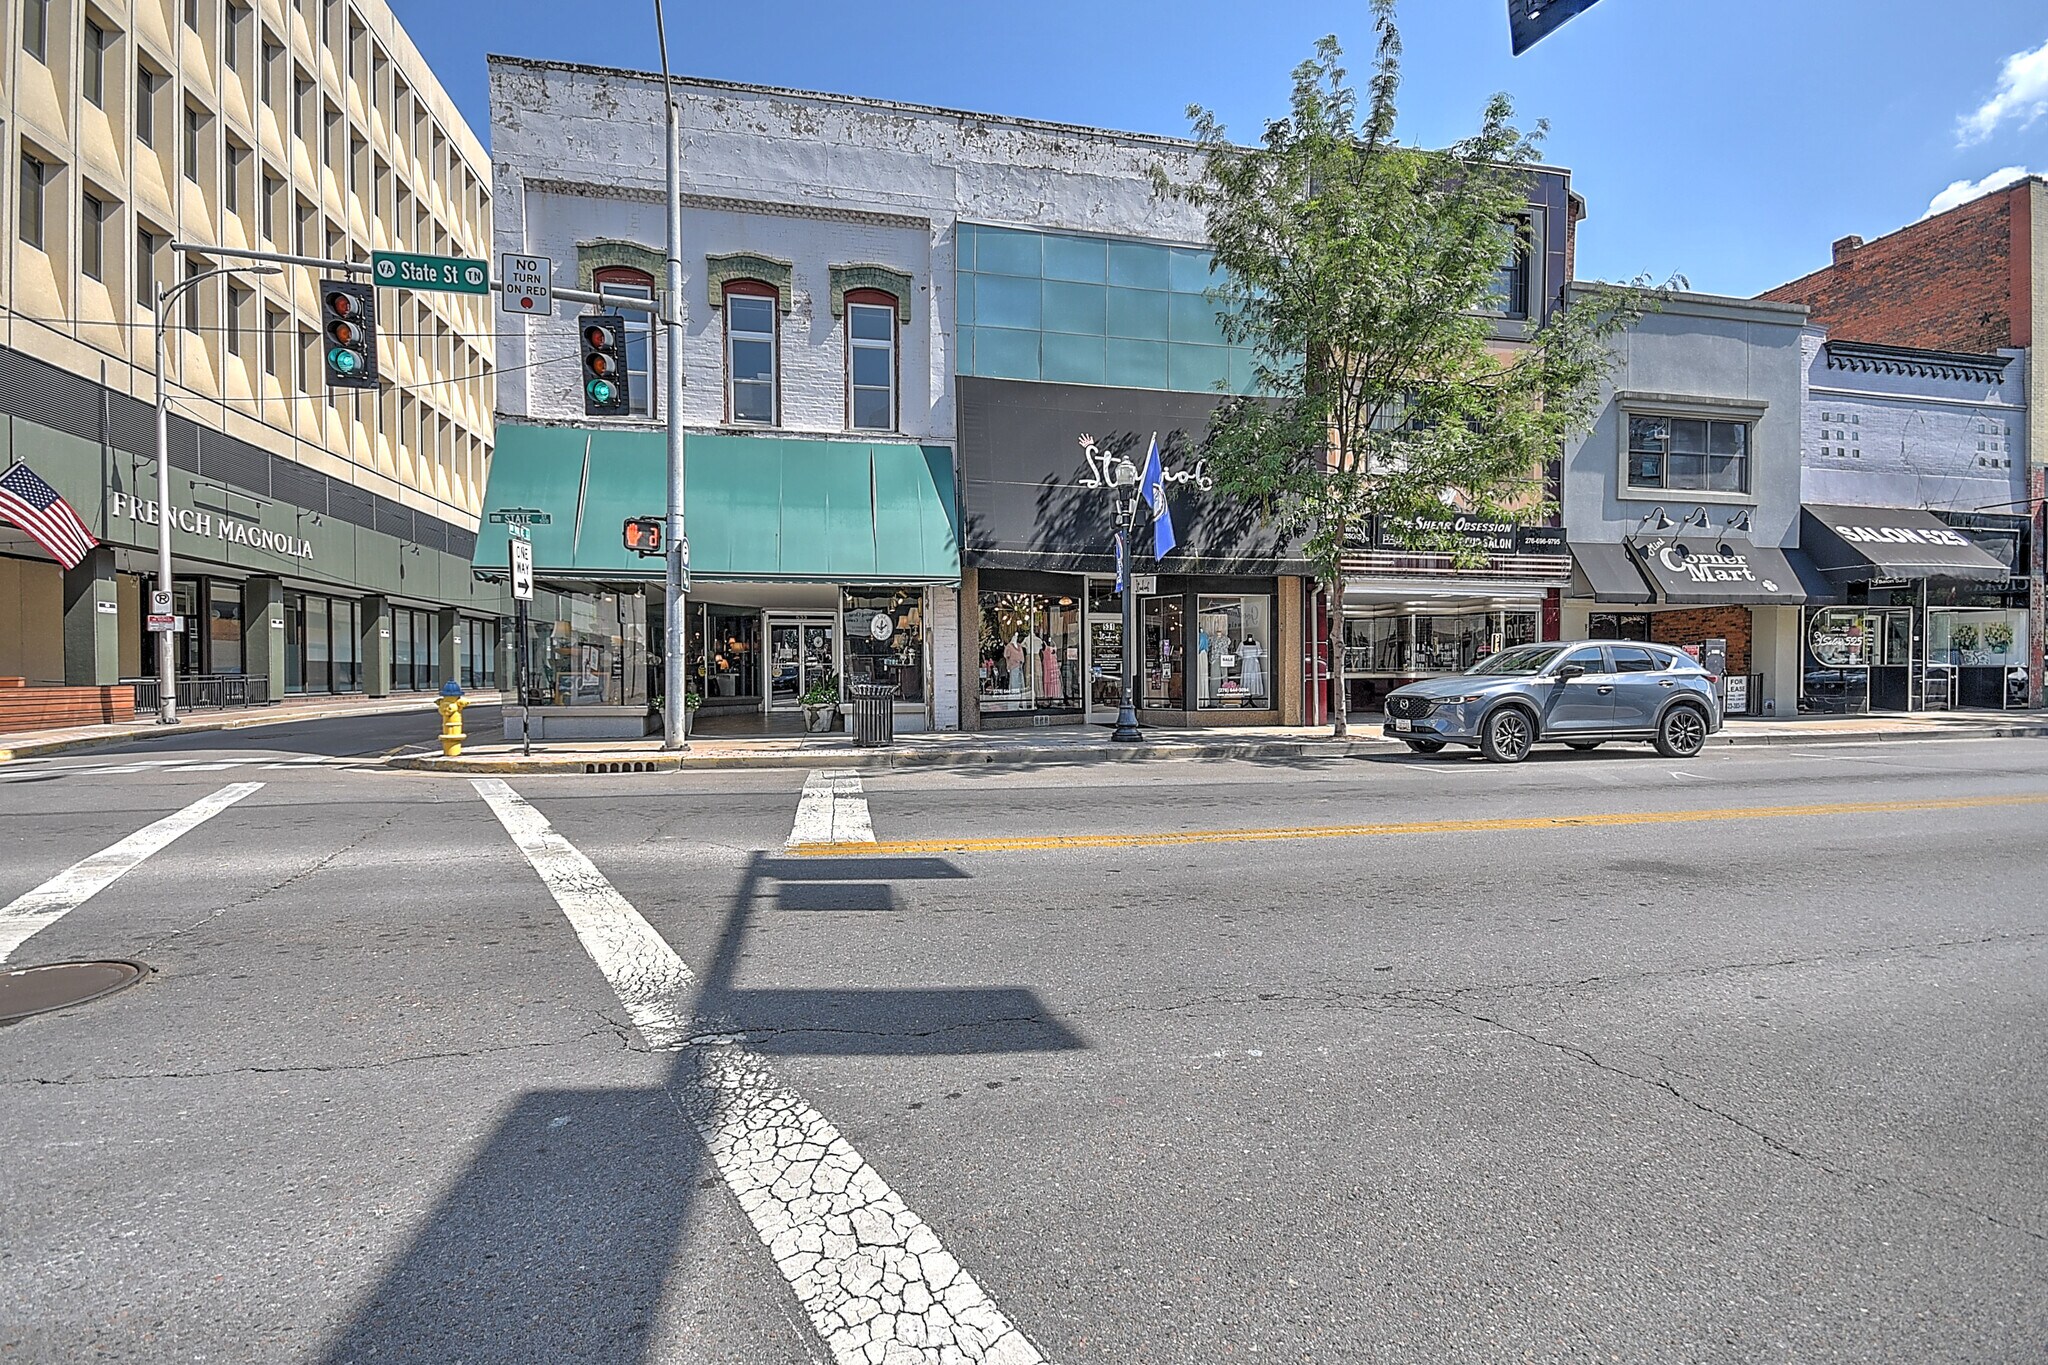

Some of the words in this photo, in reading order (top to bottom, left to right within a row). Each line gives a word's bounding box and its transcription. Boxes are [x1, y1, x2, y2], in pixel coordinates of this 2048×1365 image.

[379, 262, 395, 275] VA
[401, 261, 437, 282] State
[443, 265, 459, 284] St
[467, 270, 483, 282] TN
[516, 259, 537, 272] NO
[513, 272, 541, 284] TURN
[507, 284, 522, 294] ON
[526, 286, 547, 296] RED
[112, 491, 211, 537] FRENCH
[218, 517, 314, 560] MAGNOLIA
[504, 514, 532, 524] STATE
[1455, 517, 1512, 533] OBSESSION
[1835, 526, 1926, 544] SALON
[1920, 529, 1968, 546] 525
[516, 546, 529, 560] ONE
[1659, 547, 1748, 572] Corner
[517, 562, 530, 575] WAY
[1686, 564, 1756, 582] Mart
